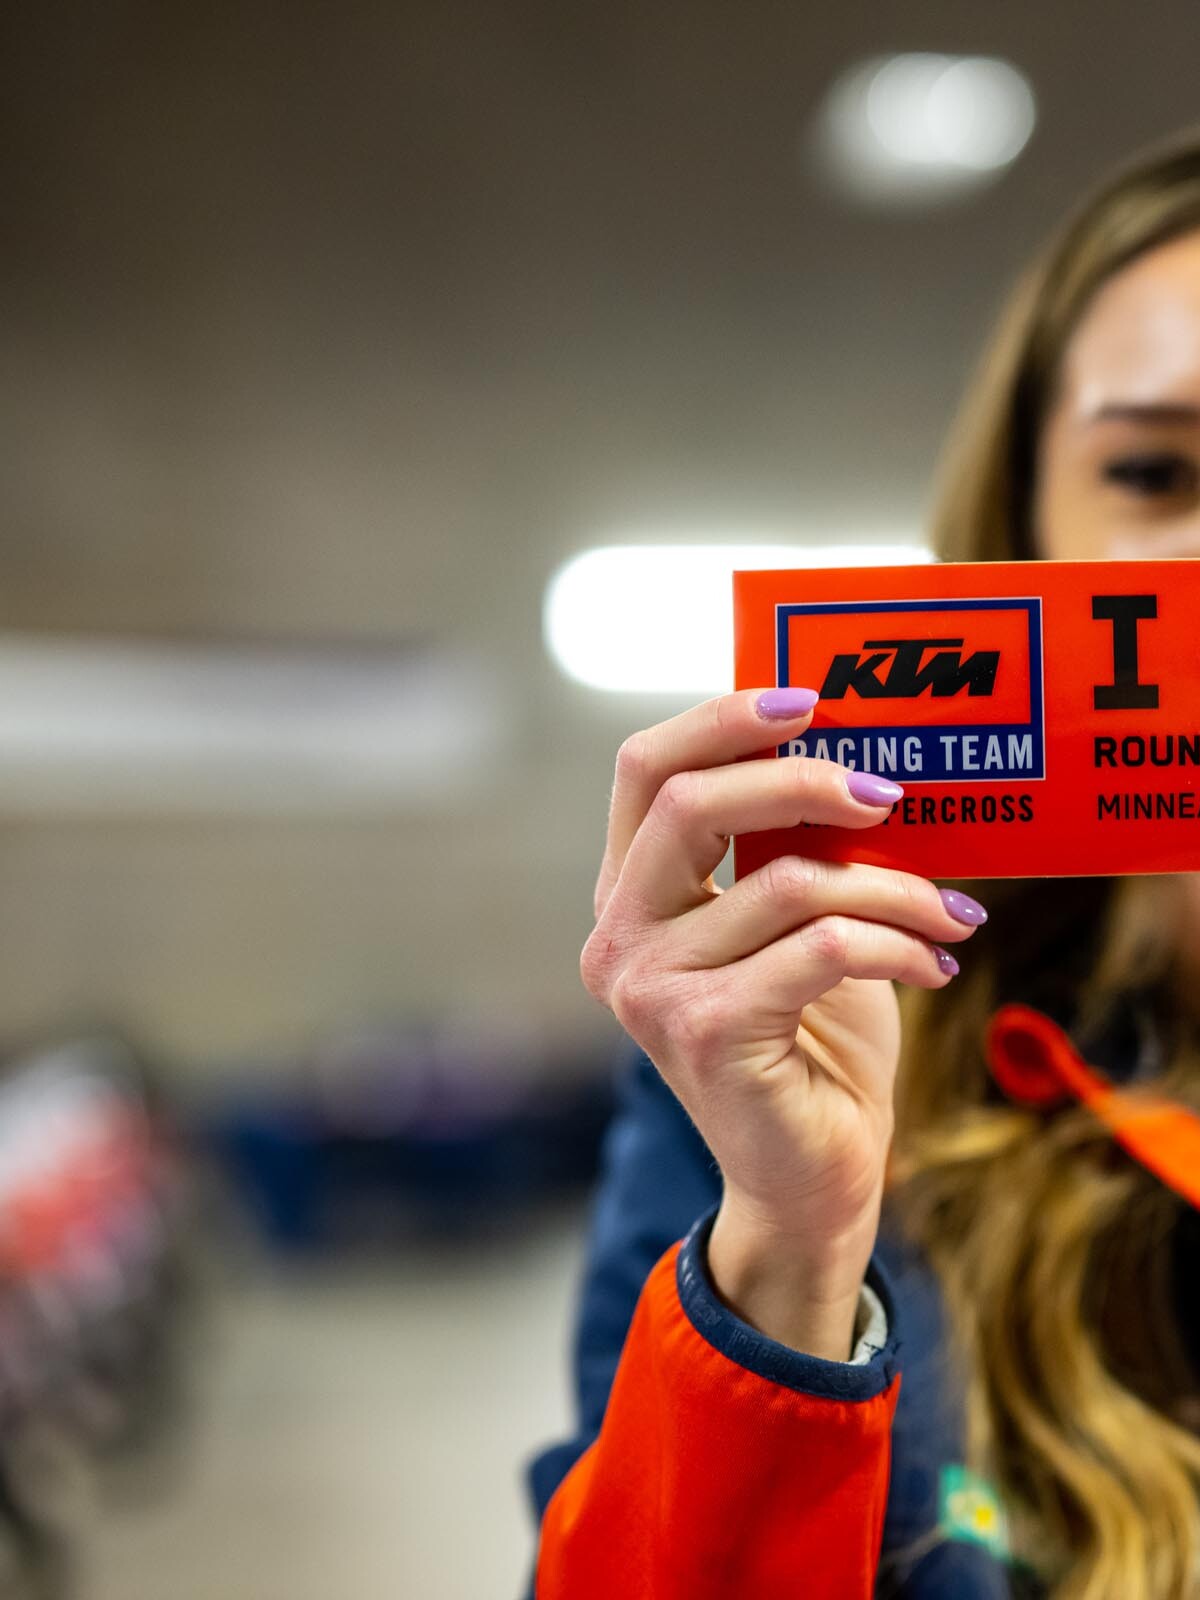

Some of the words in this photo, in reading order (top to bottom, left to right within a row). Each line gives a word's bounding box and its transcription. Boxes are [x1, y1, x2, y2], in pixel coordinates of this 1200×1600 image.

[819, 638, 1000, 700] KTM
[1092, 594, 1159, 711] I
[940, 734, 1033, 771] TEAM
